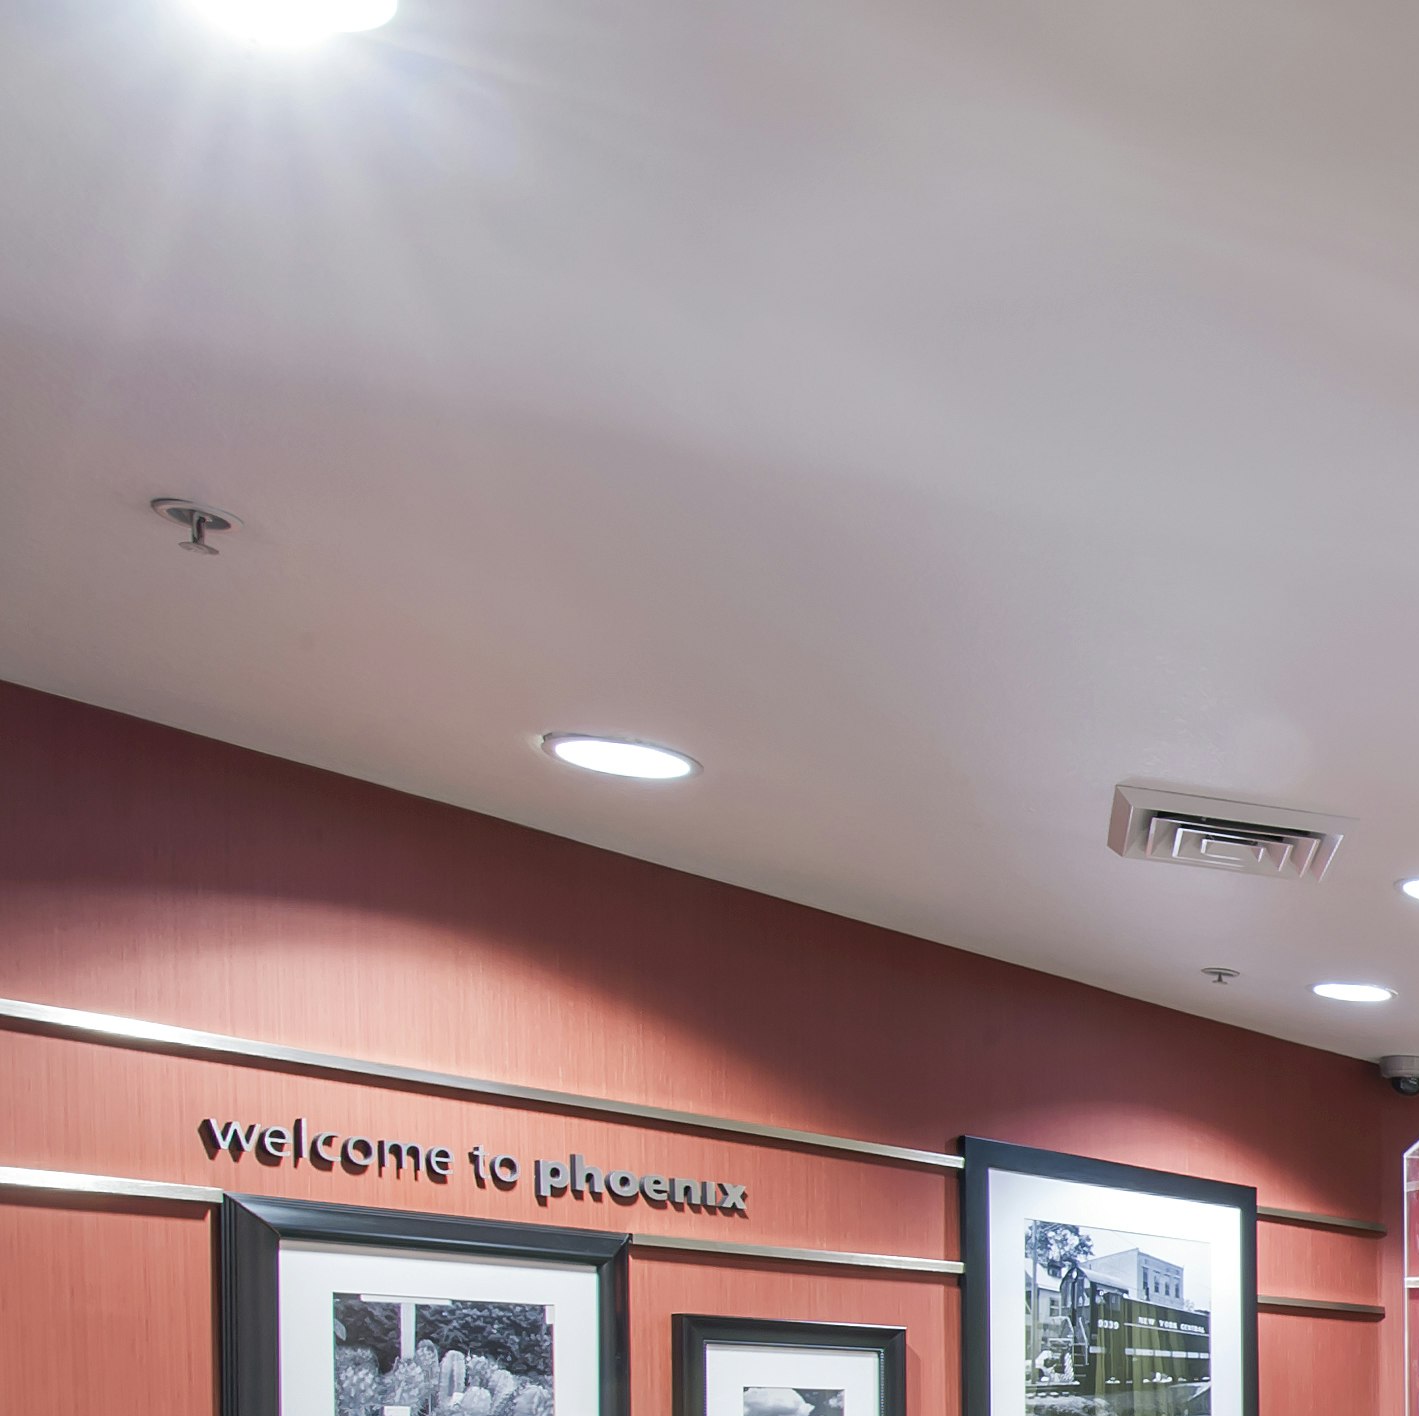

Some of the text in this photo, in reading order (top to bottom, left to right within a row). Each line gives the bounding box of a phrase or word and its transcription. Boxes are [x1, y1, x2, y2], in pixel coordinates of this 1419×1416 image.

[201, 1117, 747, 1212] welcome to phoenix
